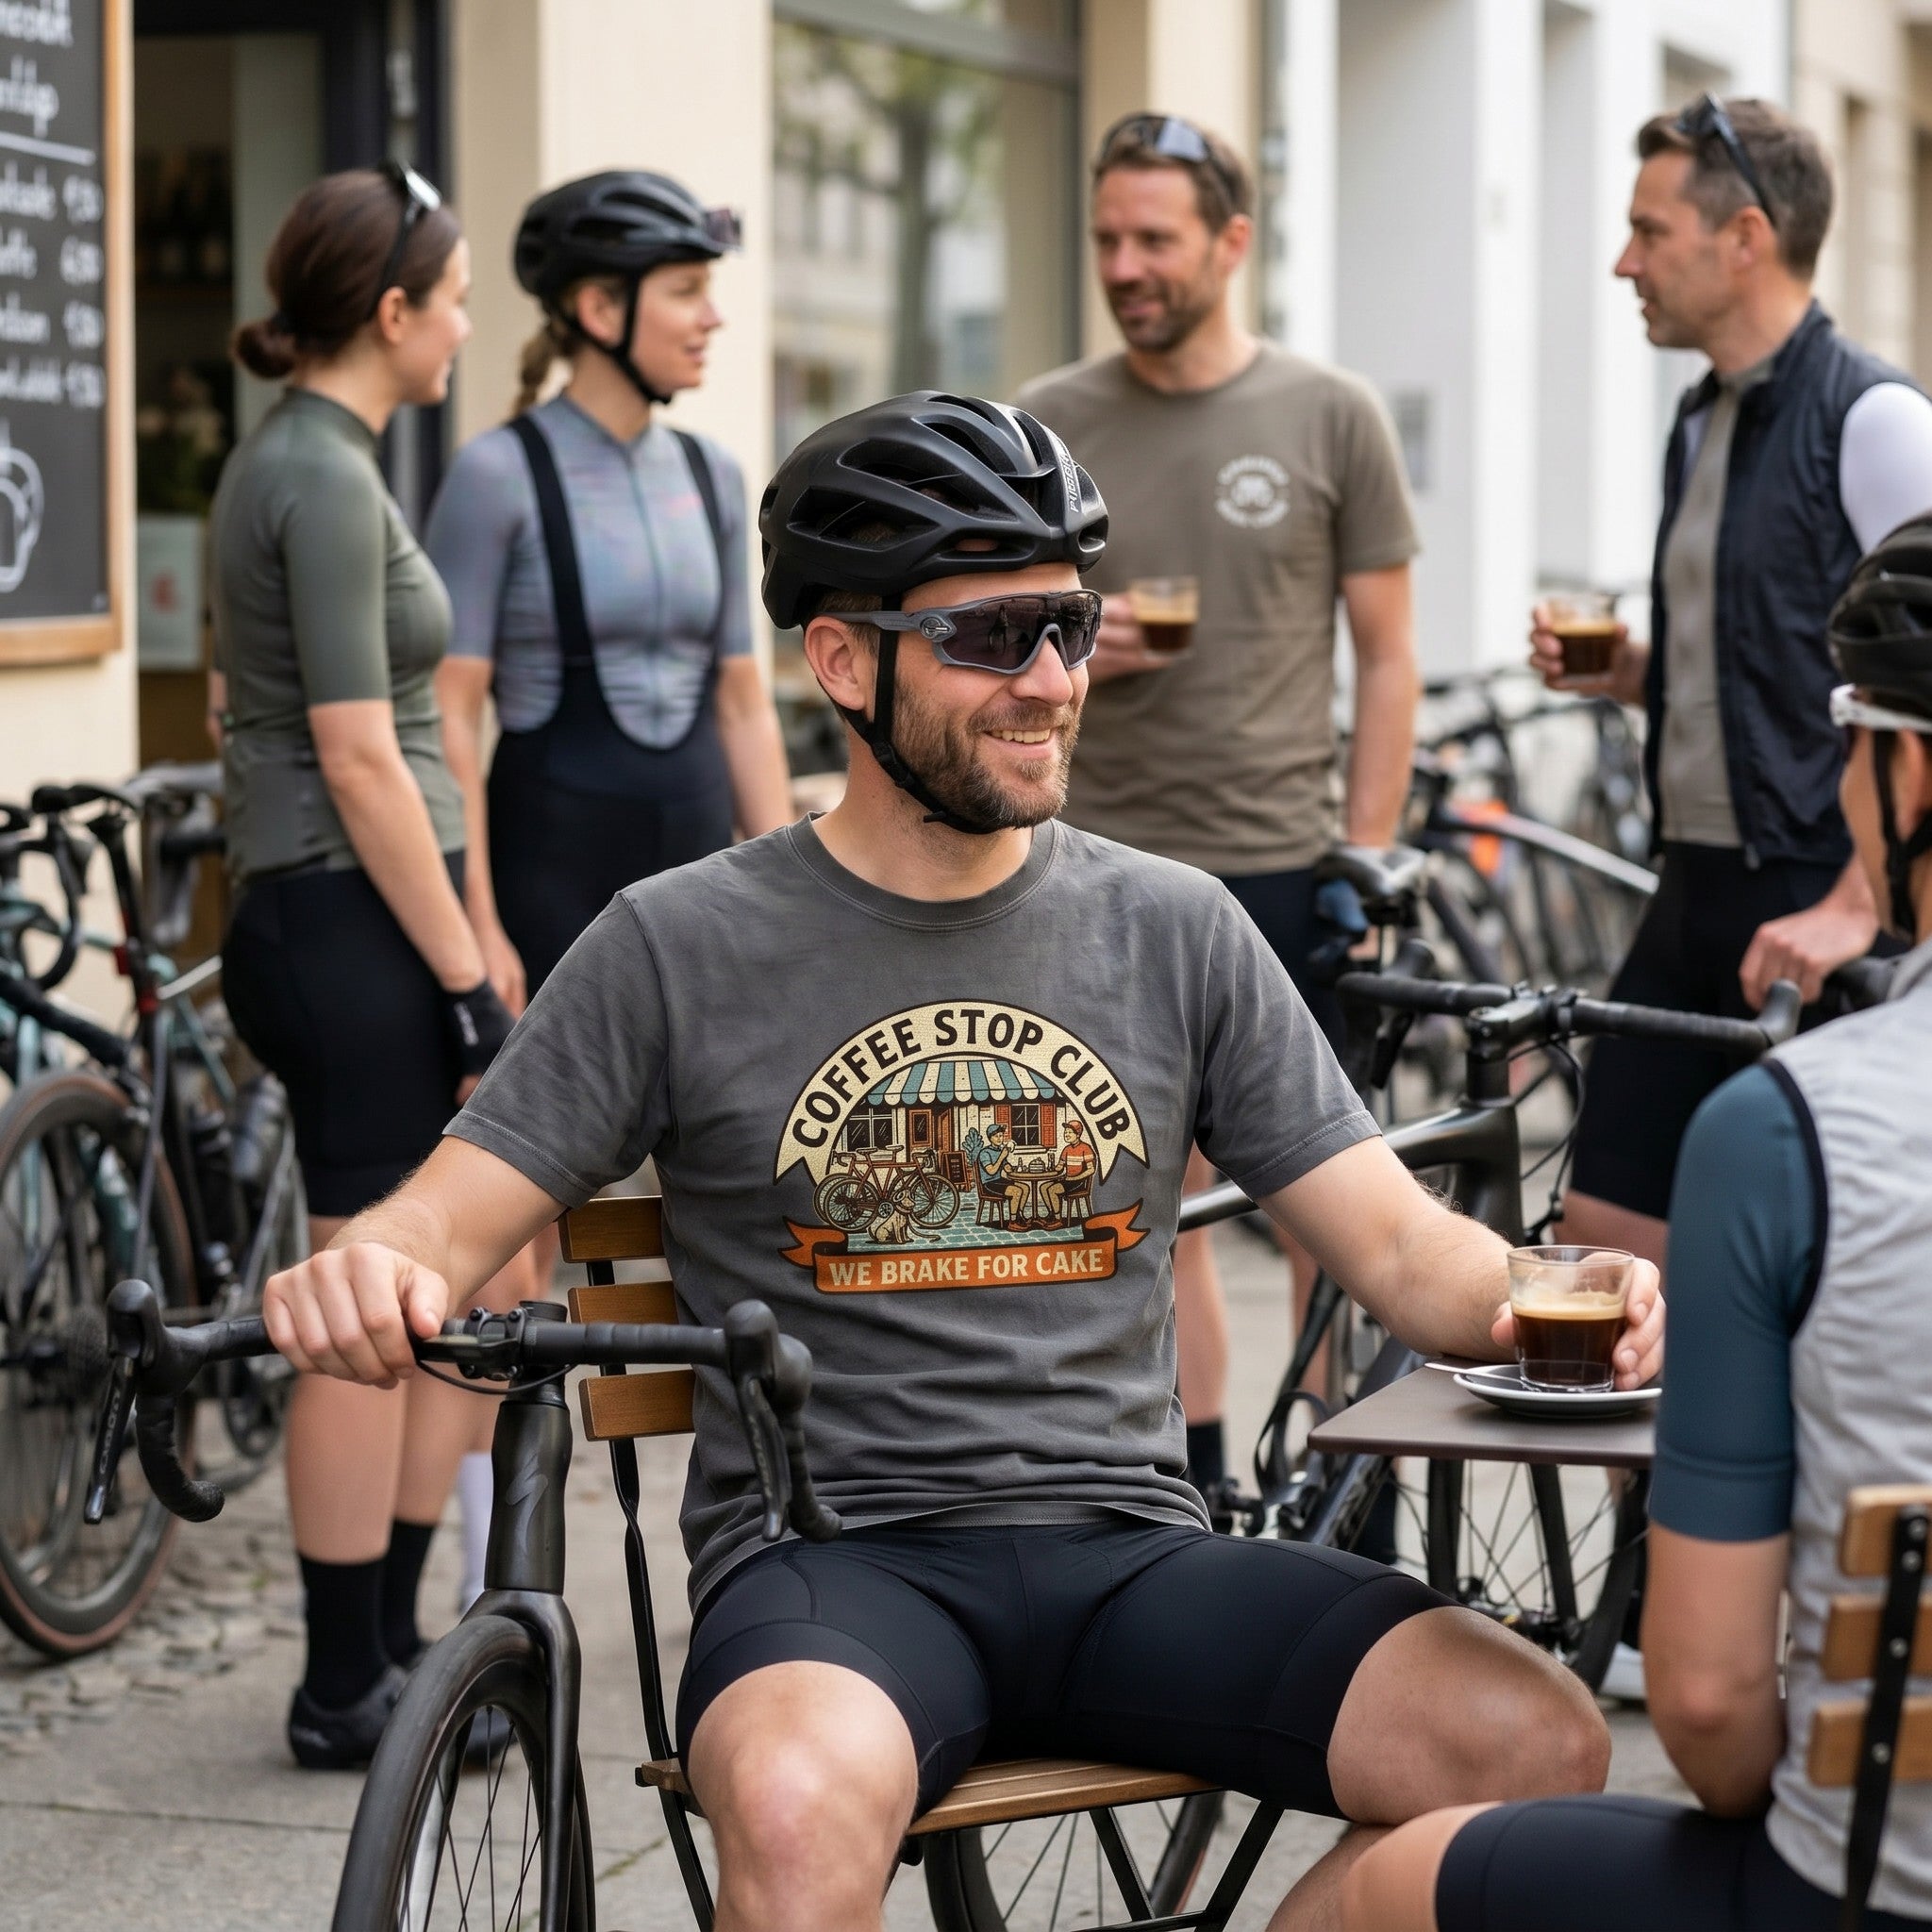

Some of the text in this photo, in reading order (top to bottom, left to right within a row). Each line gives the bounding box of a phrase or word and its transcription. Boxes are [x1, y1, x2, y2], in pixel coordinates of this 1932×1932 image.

[792, 1008, 1131, 1148] COFFEE STOP CLUB
[829, 1248, 1104, 1287] WE BRAKE FOR CAKE
